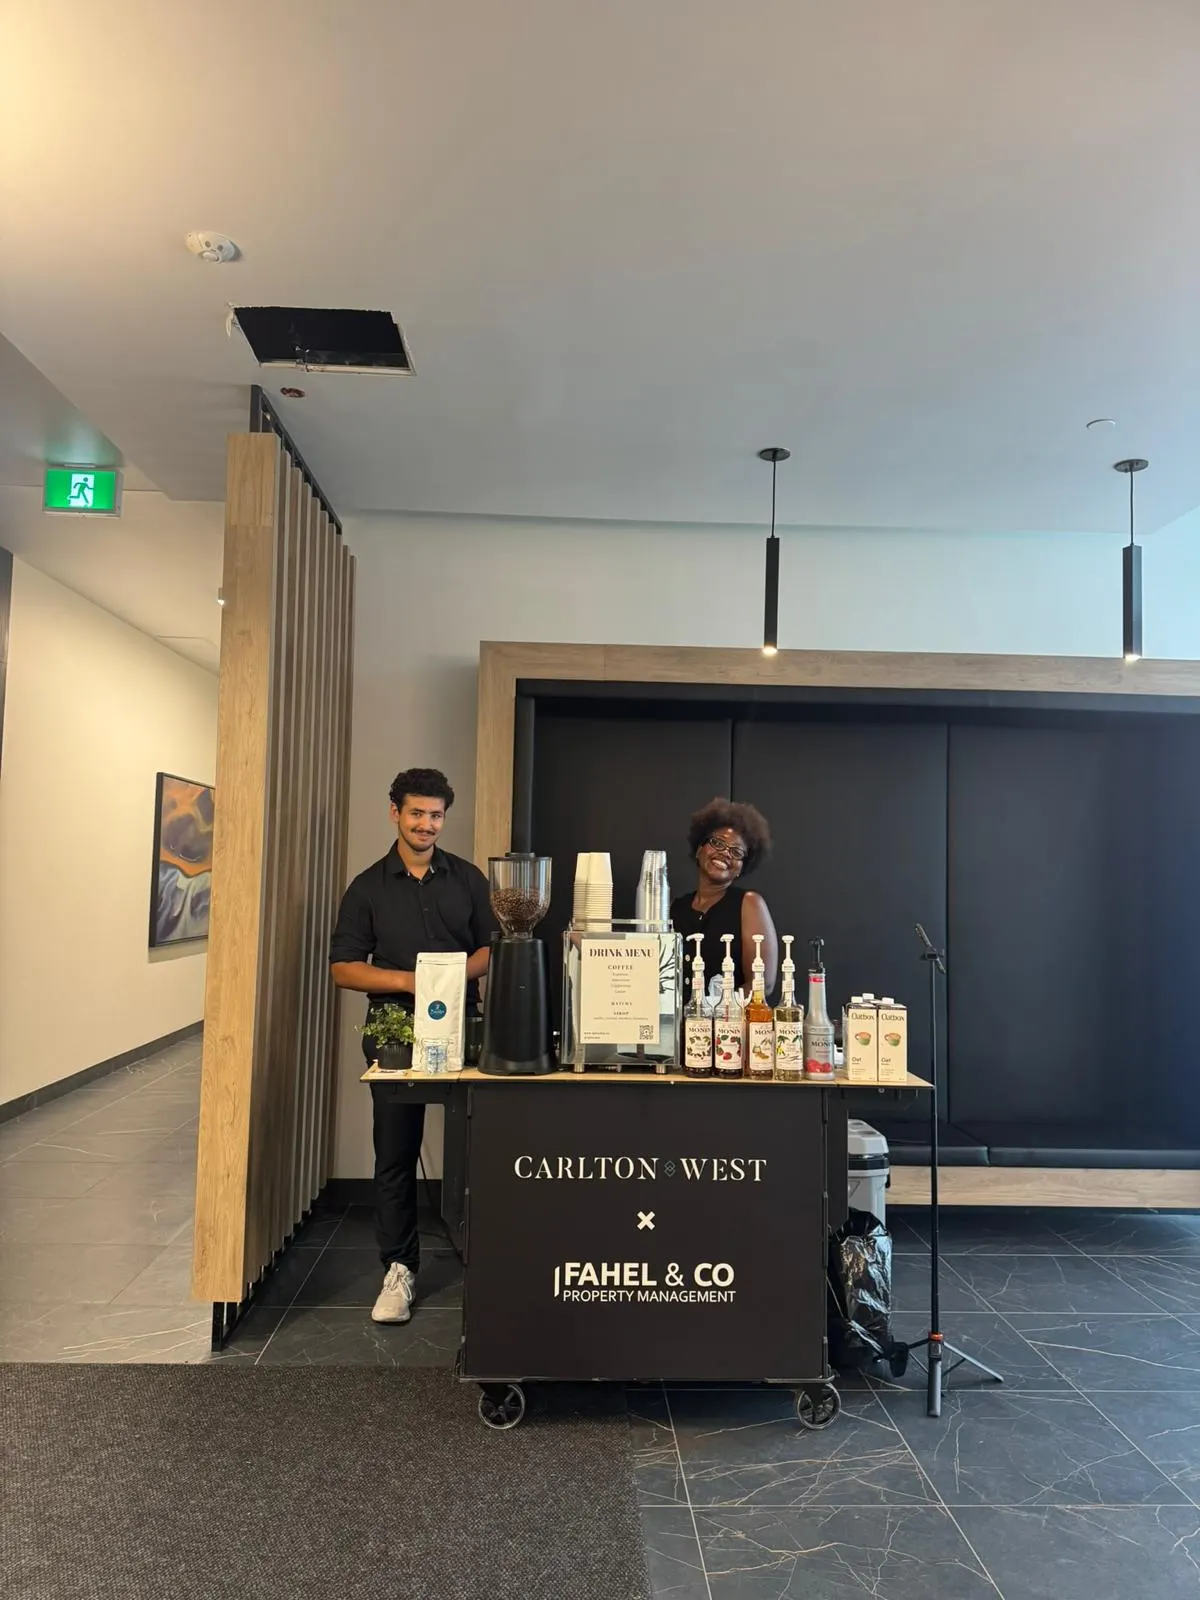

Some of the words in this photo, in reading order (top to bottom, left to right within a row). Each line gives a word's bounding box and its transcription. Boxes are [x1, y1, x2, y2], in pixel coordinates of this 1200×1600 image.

[589, 948, 622, 958] DRINK
[624, 948, 653, 958] MENU
[851, 1012, 874, 1020] Oatbox
[881, 1013, 904, 1021] Oatbox
[513, 1155, 660, 1180] CARLTON
[680, 1157, 767, 1182] WEST
[564, 1262, 657, 1286] FAHEL
[664, 1262, 685, 1287] &
[694, 1263, 735, 1287] CO
[562, 1290, 635, 1302] PROPERTY
[637, 1290, 736, 1303] MANAGEMENT
